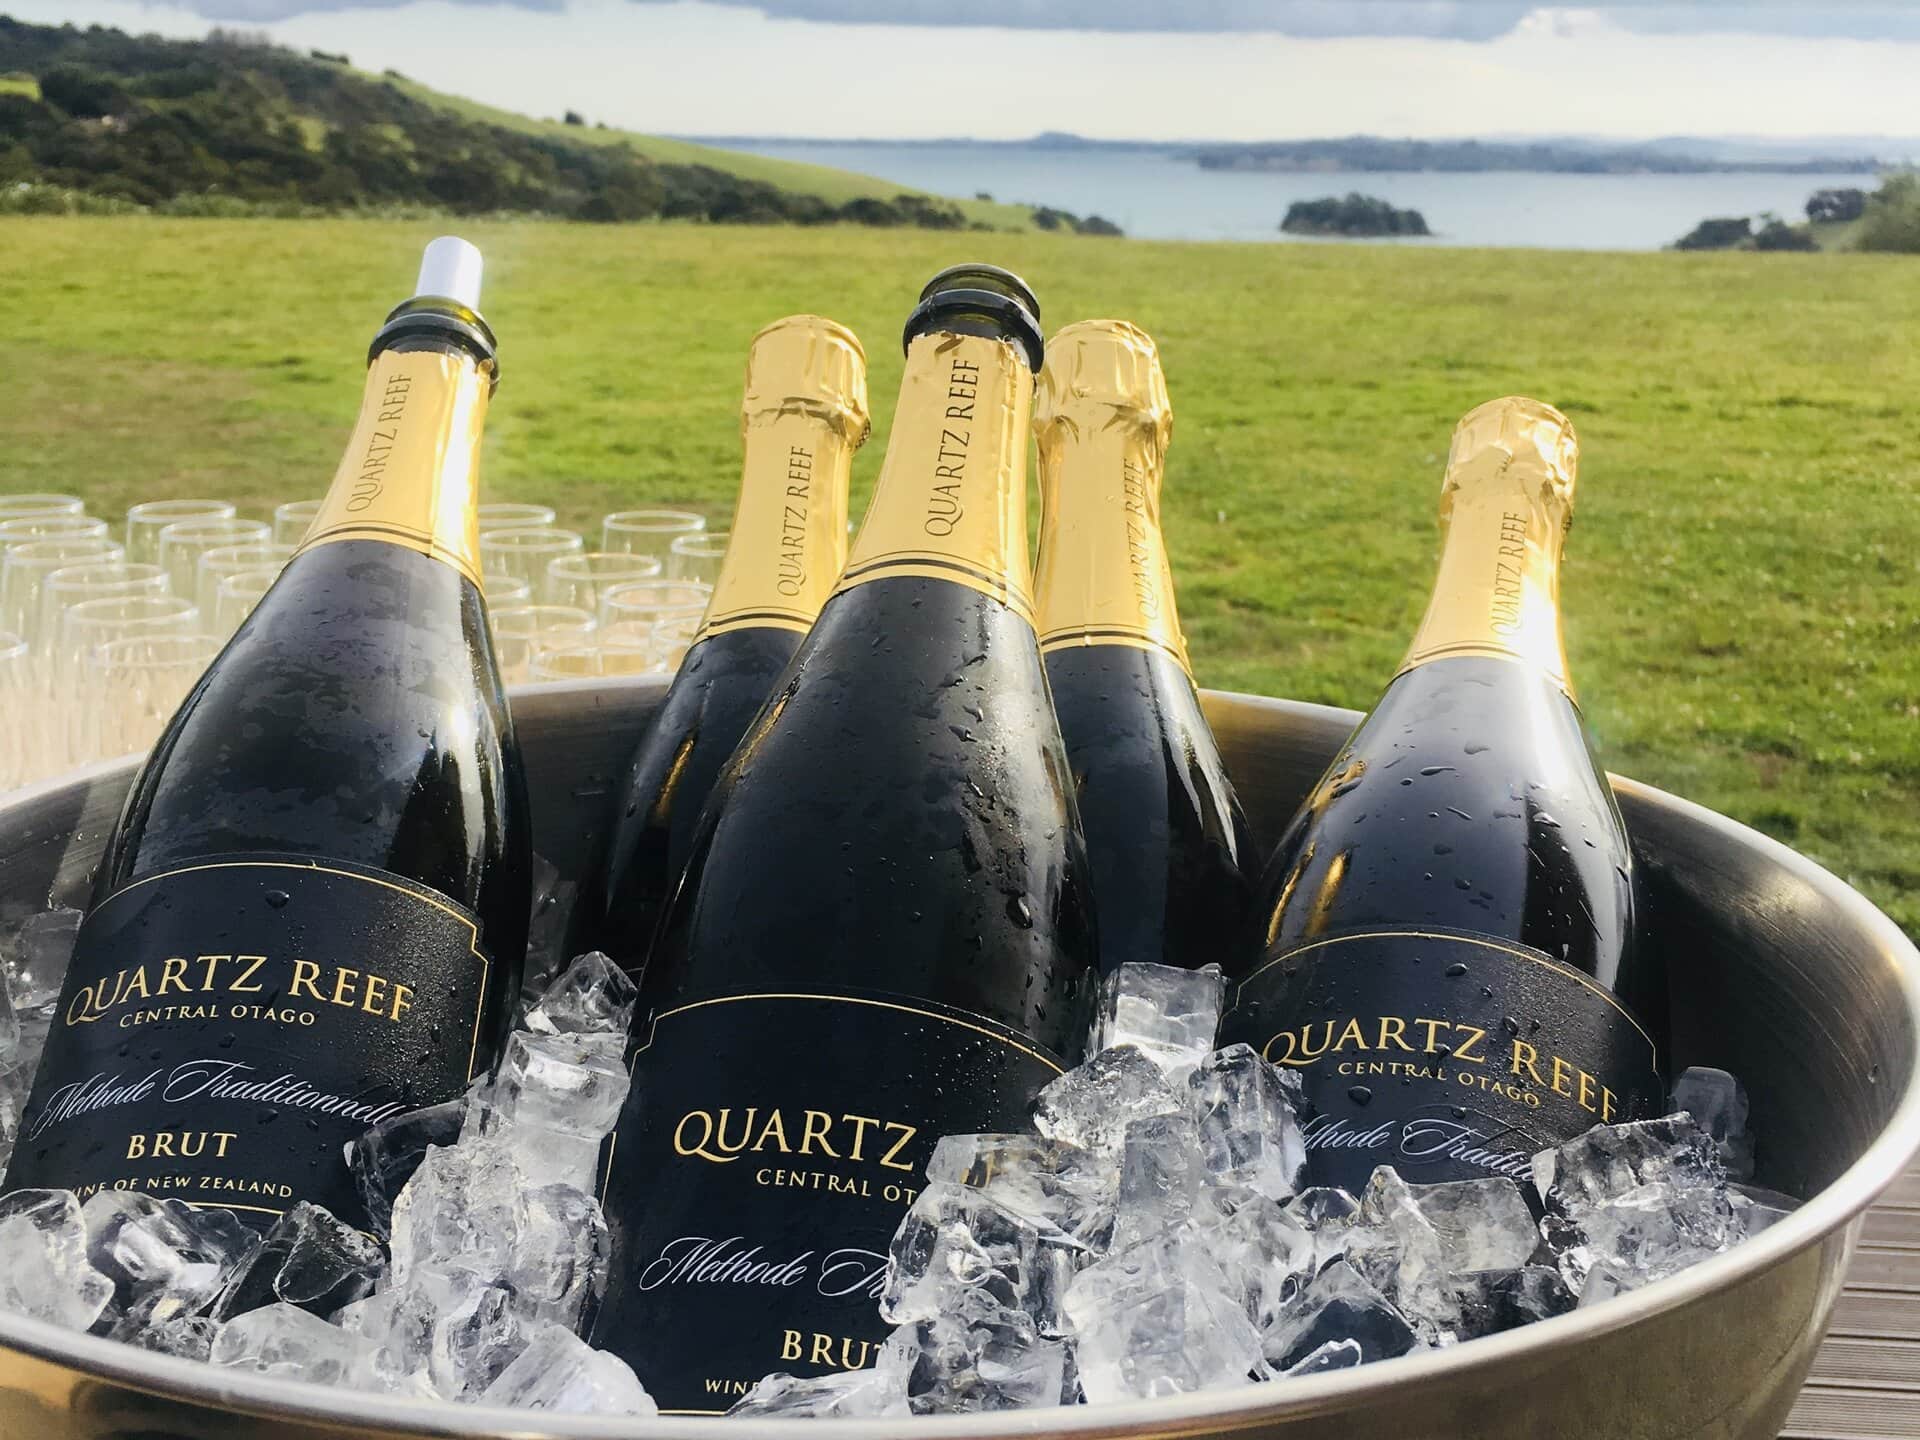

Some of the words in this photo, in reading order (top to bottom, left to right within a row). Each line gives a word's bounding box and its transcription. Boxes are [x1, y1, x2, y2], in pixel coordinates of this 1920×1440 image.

[945, 359, 979, 421] REEF
[346, 428, 398, 513] QUARTZ
[378, 374, 412, 422] REEF
[787, 446, 814, 500] REEF
[924, 428, 970, 537] QUARTZ
[1123, 459, 1146, 518] REEF
[777, 505, 808, 597] QUARTZ
[1498, 512, 1528, 559] REEF
[1126, 521, 1160, 620] QUARTZ
[1489, 562, 1524, 637] QUARTZ
[65, 954, 267, 1026] QUARTZ
[287, 959, 415, 1023] REEF
[119, 1003, 219, 1028] CENTRAL
[230, 1004, 316, 1027] OTAGO
[1263, 1016, 1488, 1066] QUARTZ
[1510, 1038, 1618, 1124] REEF
[1337, 1061, 1449, 1082] CENTRAL
[1457, 1071, 1541, 1109] OTAGO
[29, 1068, 164, 1142] Methode
[162, 1059, 407, 1127] Traditionnell
[125, 1132, 238, 1160] BRUT
[673, 1107, 919, 1171] QUARTZ
[72, 1182, 107, 1198] INE
[114, 1177, 139, 1191] OF
[146, 1176, 191, 1189] NEW
[199, 1176, 293, 1198] ZEALAND
[755, 1168, 872, 1197] CENTRAL
[639, 1236, 816, 1291] Methode
[779, 1329, 882, 1370] BRU
